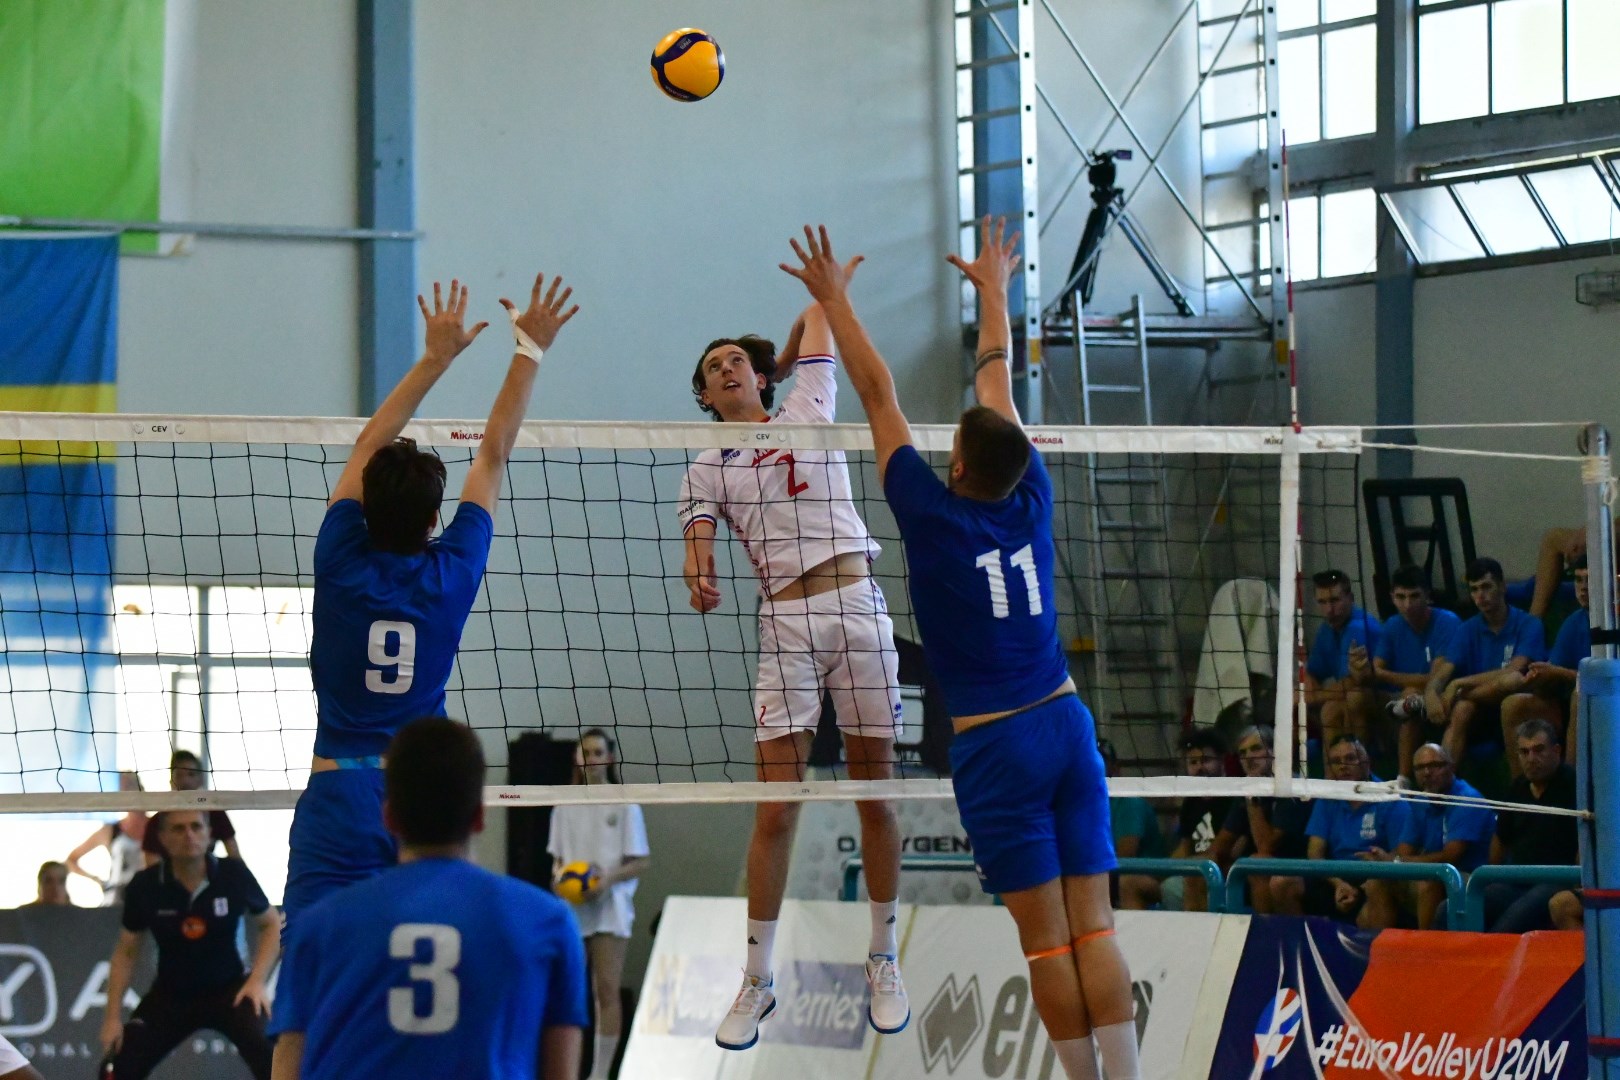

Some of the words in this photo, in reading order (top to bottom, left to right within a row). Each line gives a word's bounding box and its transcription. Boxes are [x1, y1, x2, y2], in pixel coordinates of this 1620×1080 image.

[450, 429, 484, 440] MIKASA
[1031, 434, 1064, 444] MIKASA
[774, 453, 809, 498] 2
[975, 543, 1043, 619] 11
[365, 620, 416, 694] 9
[837, 835, 972, 852] OYGEN
[388, 922, 461, 1035] 3
